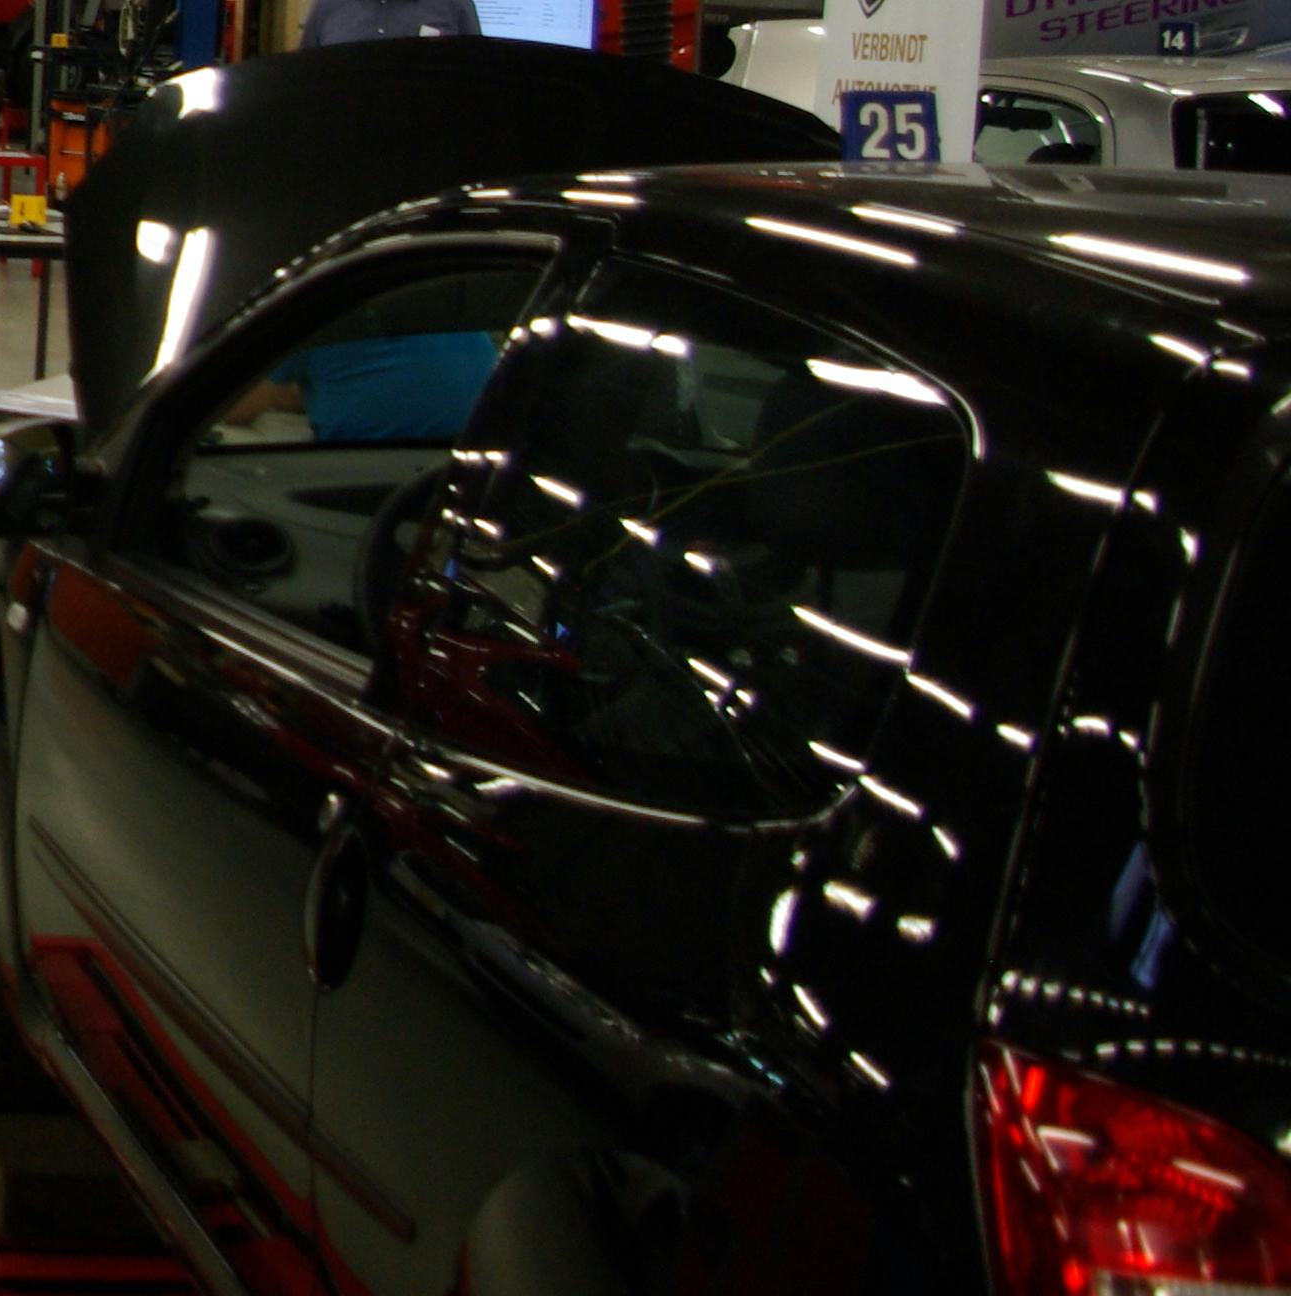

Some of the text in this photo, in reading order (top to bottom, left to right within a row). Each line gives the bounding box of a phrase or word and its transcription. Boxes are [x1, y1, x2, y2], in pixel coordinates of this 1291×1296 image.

[851, 32, 928, 63] VERBINDT
[1161, 30, 1187, 50] 14
[859, 102, 927, 161] 25
